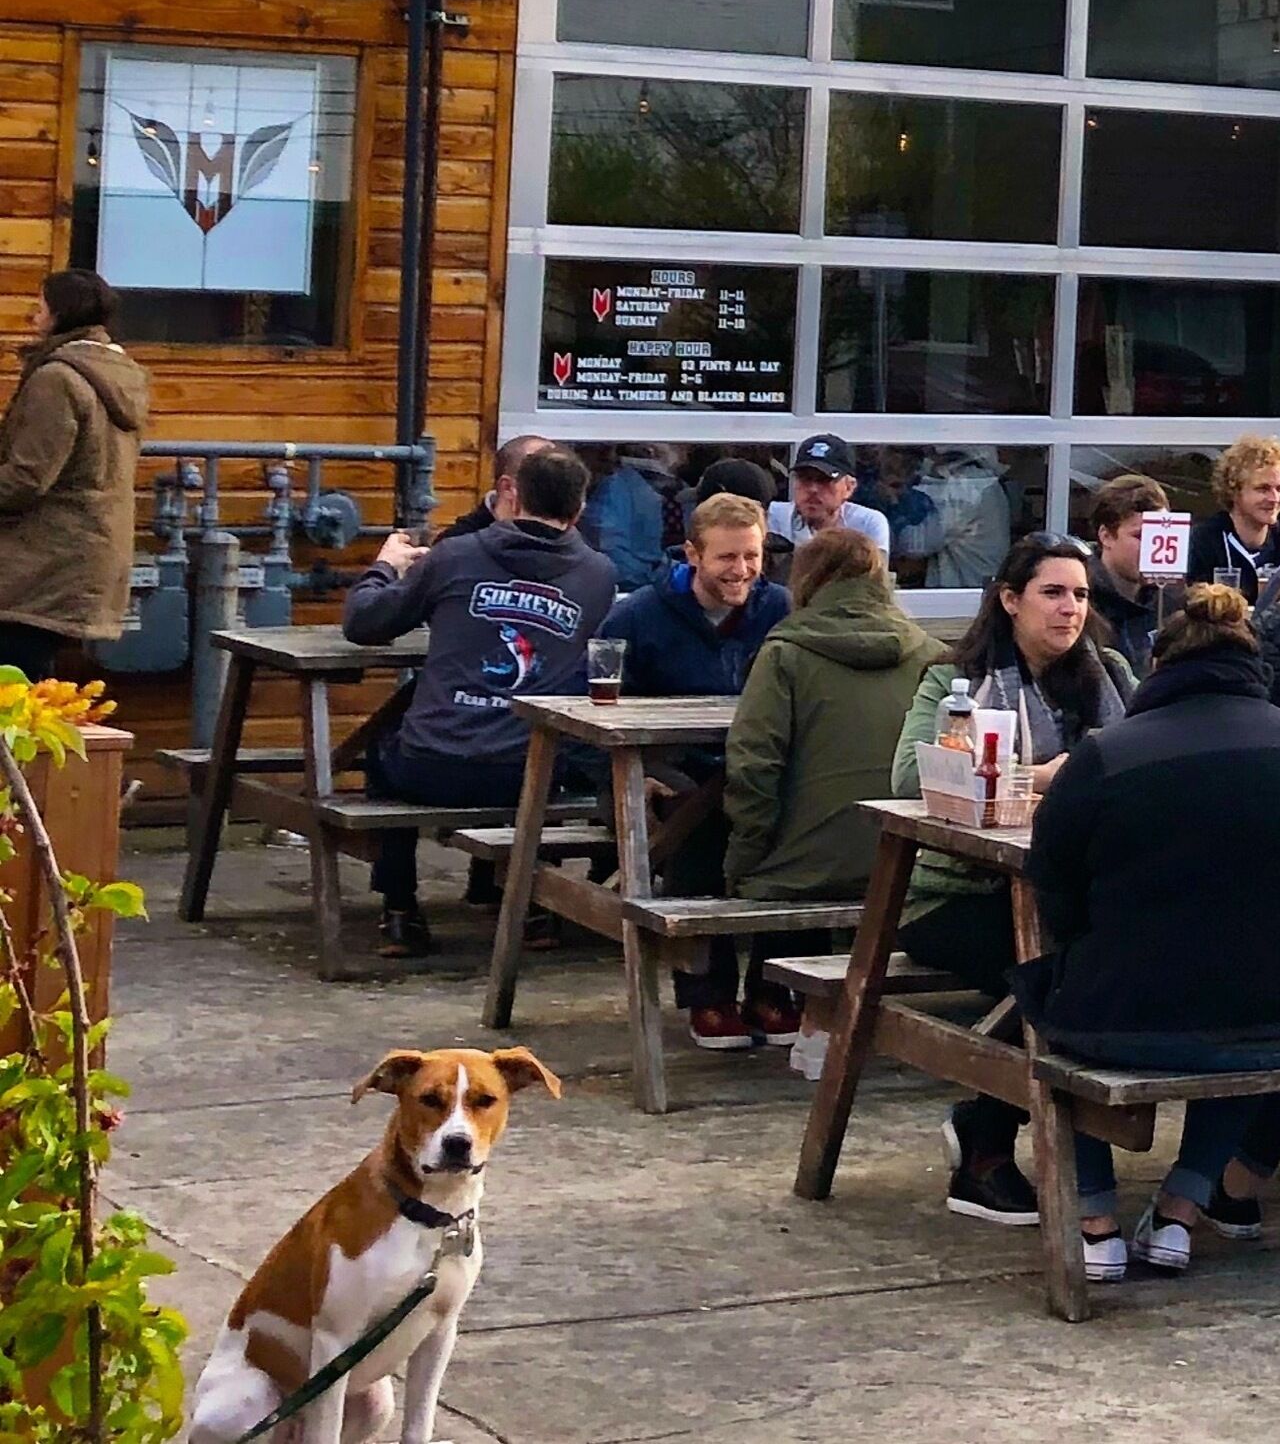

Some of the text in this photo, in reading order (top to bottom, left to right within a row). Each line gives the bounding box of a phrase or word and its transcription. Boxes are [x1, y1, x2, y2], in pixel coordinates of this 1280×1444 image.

[651, 269, 696, 286] HOURS
[615, 301, 671, 313] SATURDAY
[615, 315, 658, 327] SUNDAY
[627, 340, 712, 357] HAPPY HOUR
[577, 357, 622, 369] MONDAY
[699, 360, 732, 372] PINTS
[735, 361, 756, 372] ALL
[759, 361, 781, 373] DAY
[547, 388, 786, 404] DURING ALL TIMBERS AND BLAZERS GAMES
[1150, 534, 1178, 565] 25
[476, 586, 578, 630] SOCKEYES
